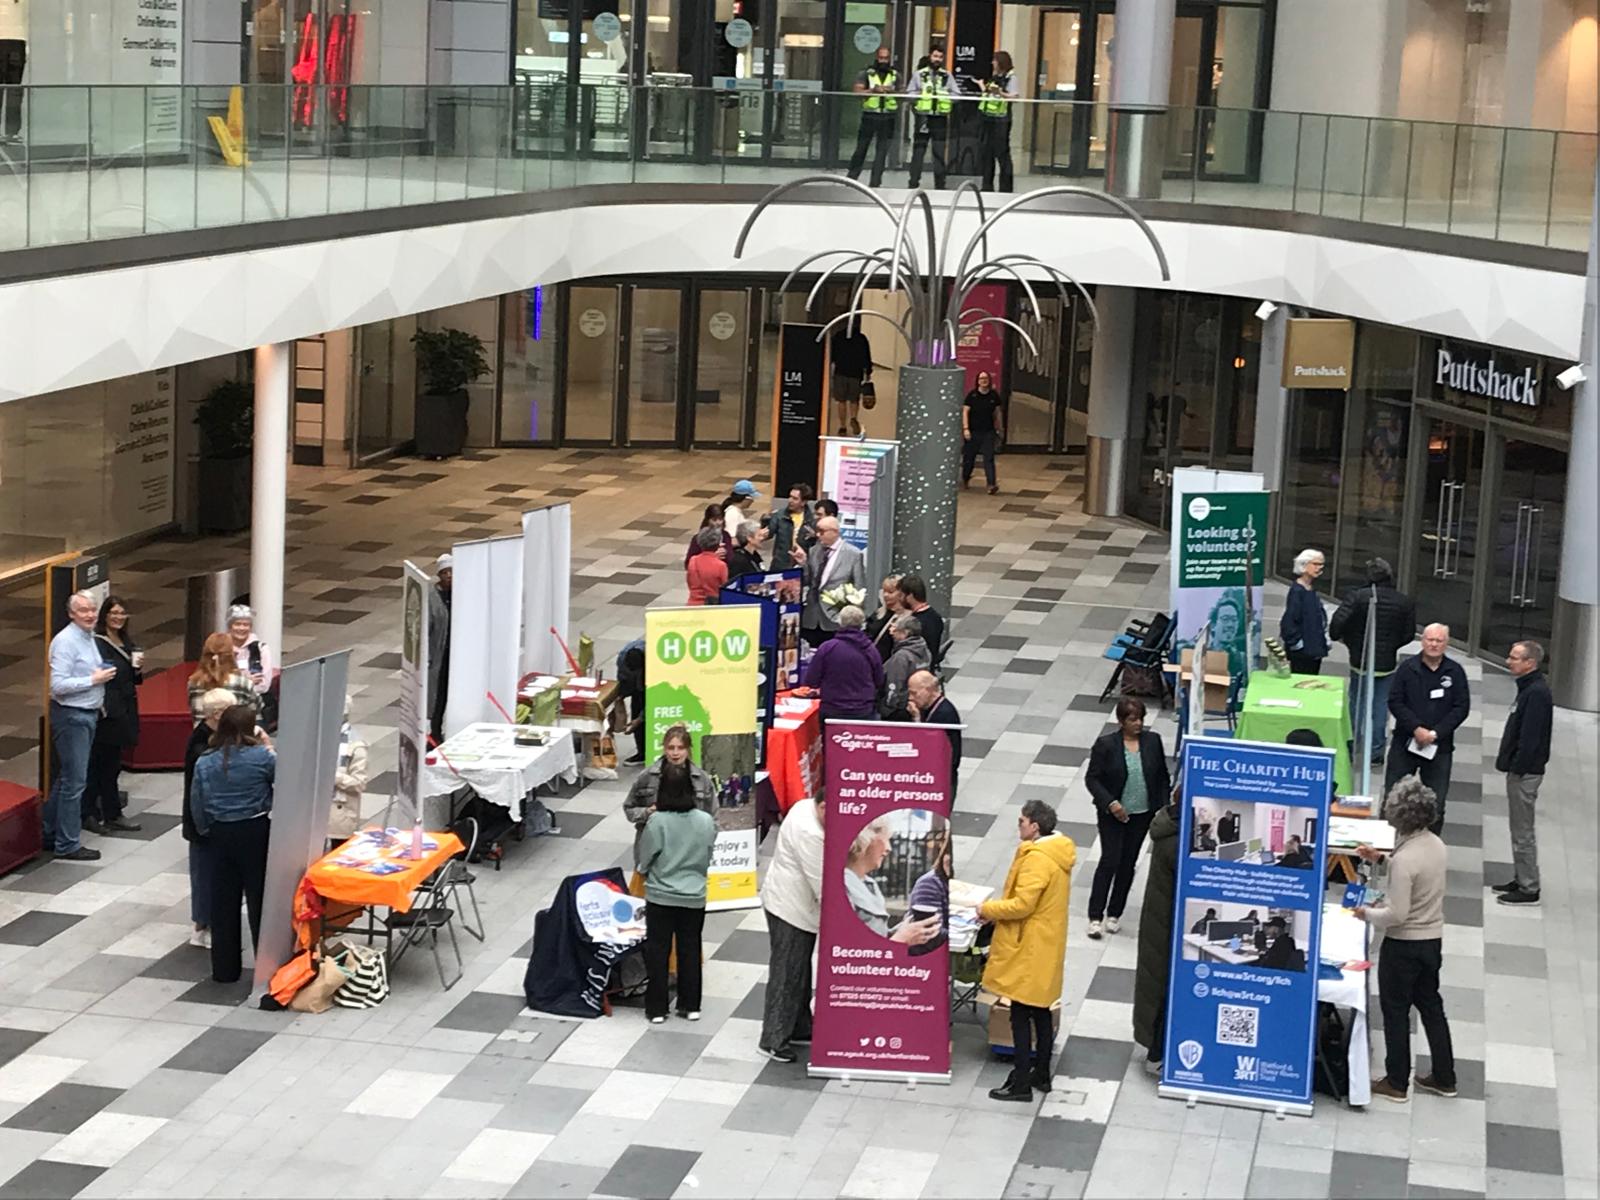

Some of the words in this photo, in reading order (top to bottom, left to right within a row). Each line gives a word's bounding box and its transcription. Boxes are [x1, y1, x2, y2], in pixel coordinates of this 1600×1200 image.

[784, 371, 802, 382] LM
[1294, 365, 1347, 377] Puttshack
[1436, 349, 1537, 406] Puttshack
[1187, 526, 1239, 541] Looking
[1242, 528, 1257, 538] to
[1186, 540, 1258, 553] volunteer?
[653, 705, 684, 719] FREE
[1190, 755, 1221, 772] THE
[1223, 759, 1290, 778] CHARITY
[1293, 765, 1326, 782] HUB
[840, 769, 866, 781] Can
[867, 774, 891, 784] you
[893, 771, 935, 784] enrich
[839, 787, 856, 797] an
[858, 786, 893, 799] older
[893, 790, 944, 802] persons
[838, 802, 868, 815] life?
[742, 841, 748, 849] a
[720, 856, 749, 867] today
[832, 945, 883, 958] Become
[884, 950, 894, 959] a
[831, 962, 893, 976] volunteer
[894, 965, 931, 981] today
[1237, 1055, 1256, 1071] W
